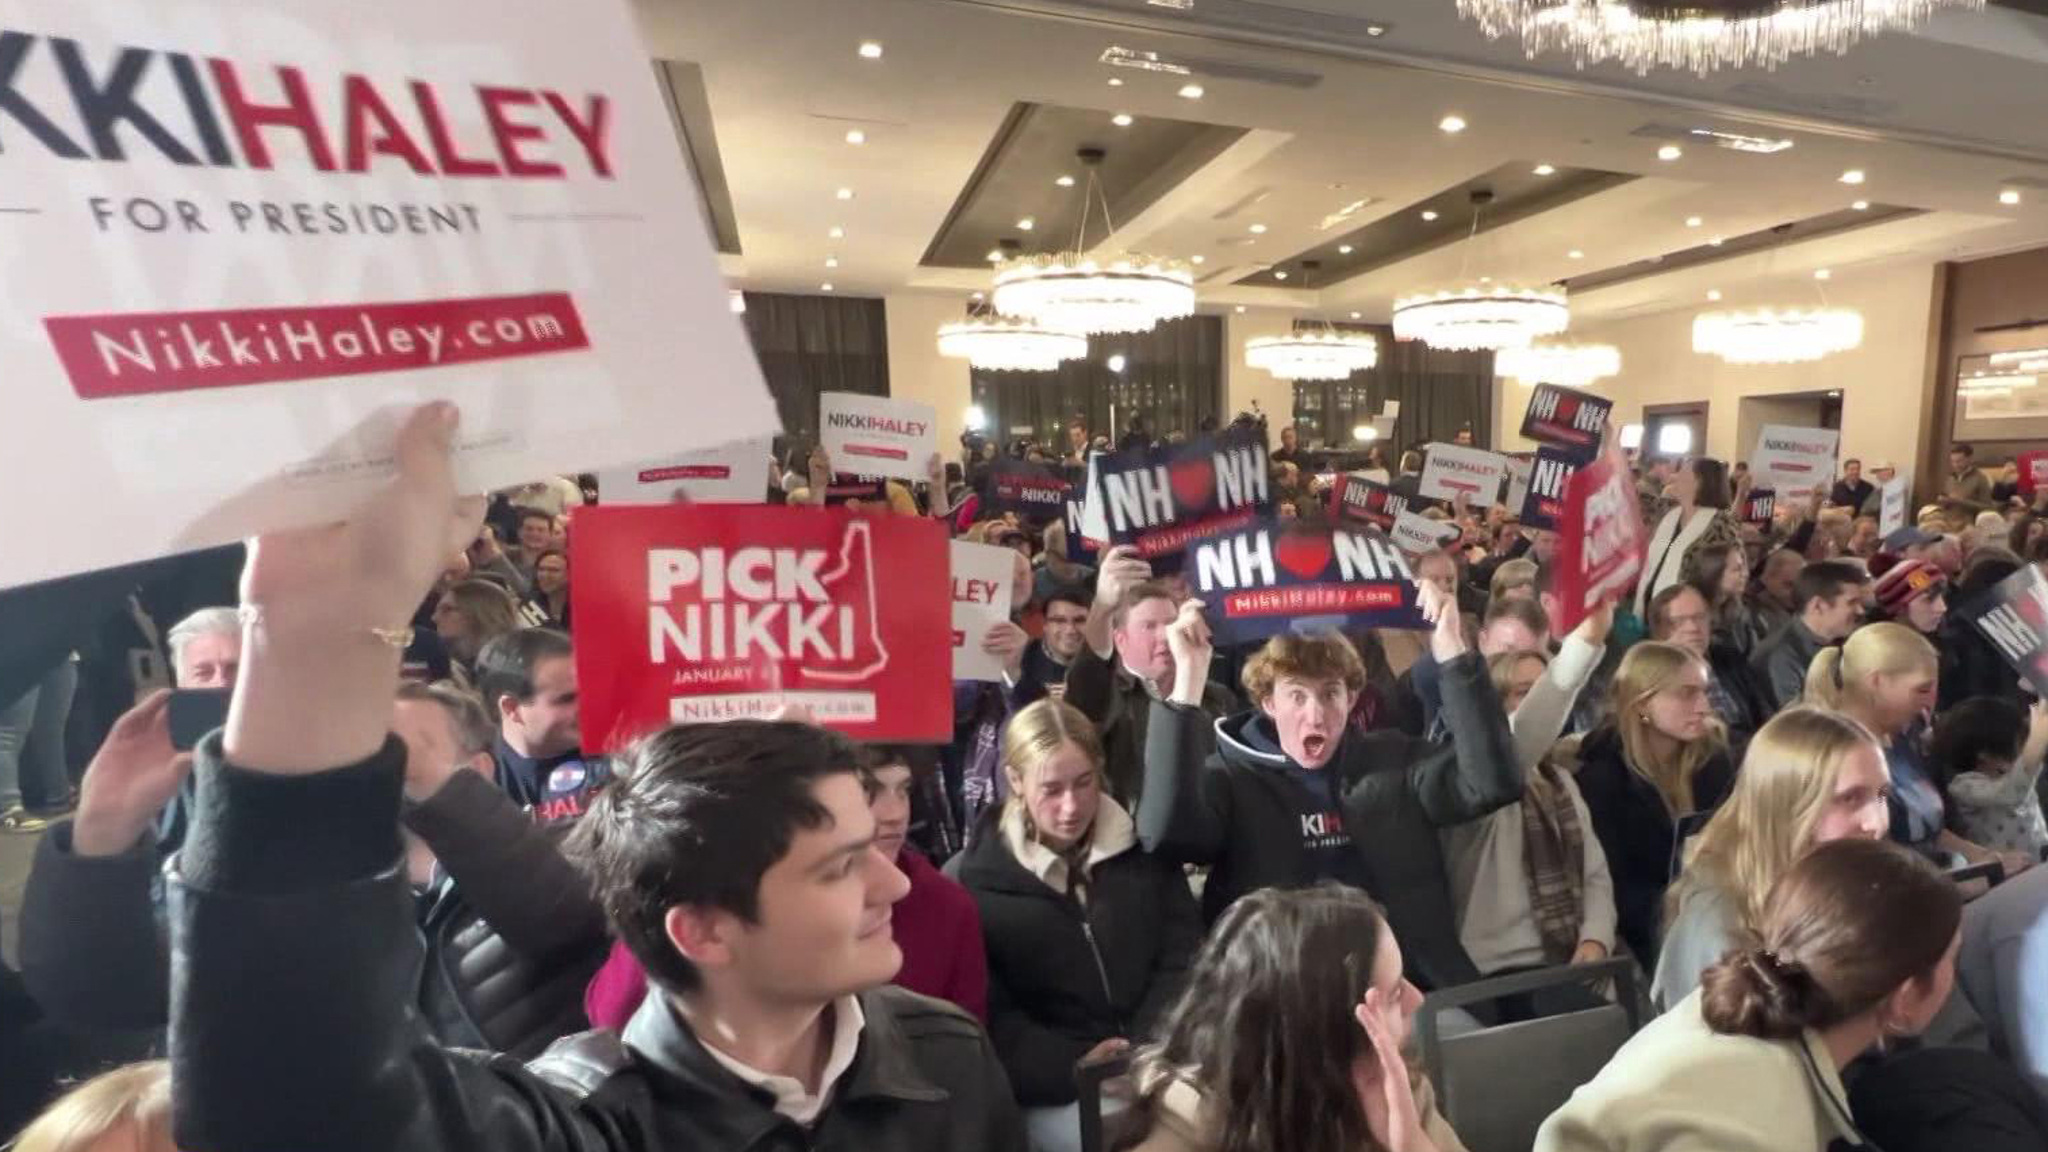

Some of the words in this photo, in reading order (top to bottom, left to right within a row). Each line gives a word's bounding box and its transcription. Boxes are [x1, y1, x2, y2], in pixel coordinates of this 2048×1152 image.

[88, 197, 208, 236] FOR
[230, 199, 483, 236] PRESIDENT
[92, 312, 565, 376] NikkiHaley.com
[827, 412, 928, 437] NIKKIHALEY
[1021, 486, 1061, 505] NIKKI
[1104, 464, 1174, 532] NH
[1214, 444, 1268, 512] NH
[1343, 481, 1370, 507] NH
[648, 547, 830, 601] PICK
[1196, 529, 1276, 592] NH
[1333, 530, 1413, 582] NH
[649, 603, 854, 664] NIKKI
[1977, 602, 2042, 661] NH
[672, 665, 754, 686] JANUARY
